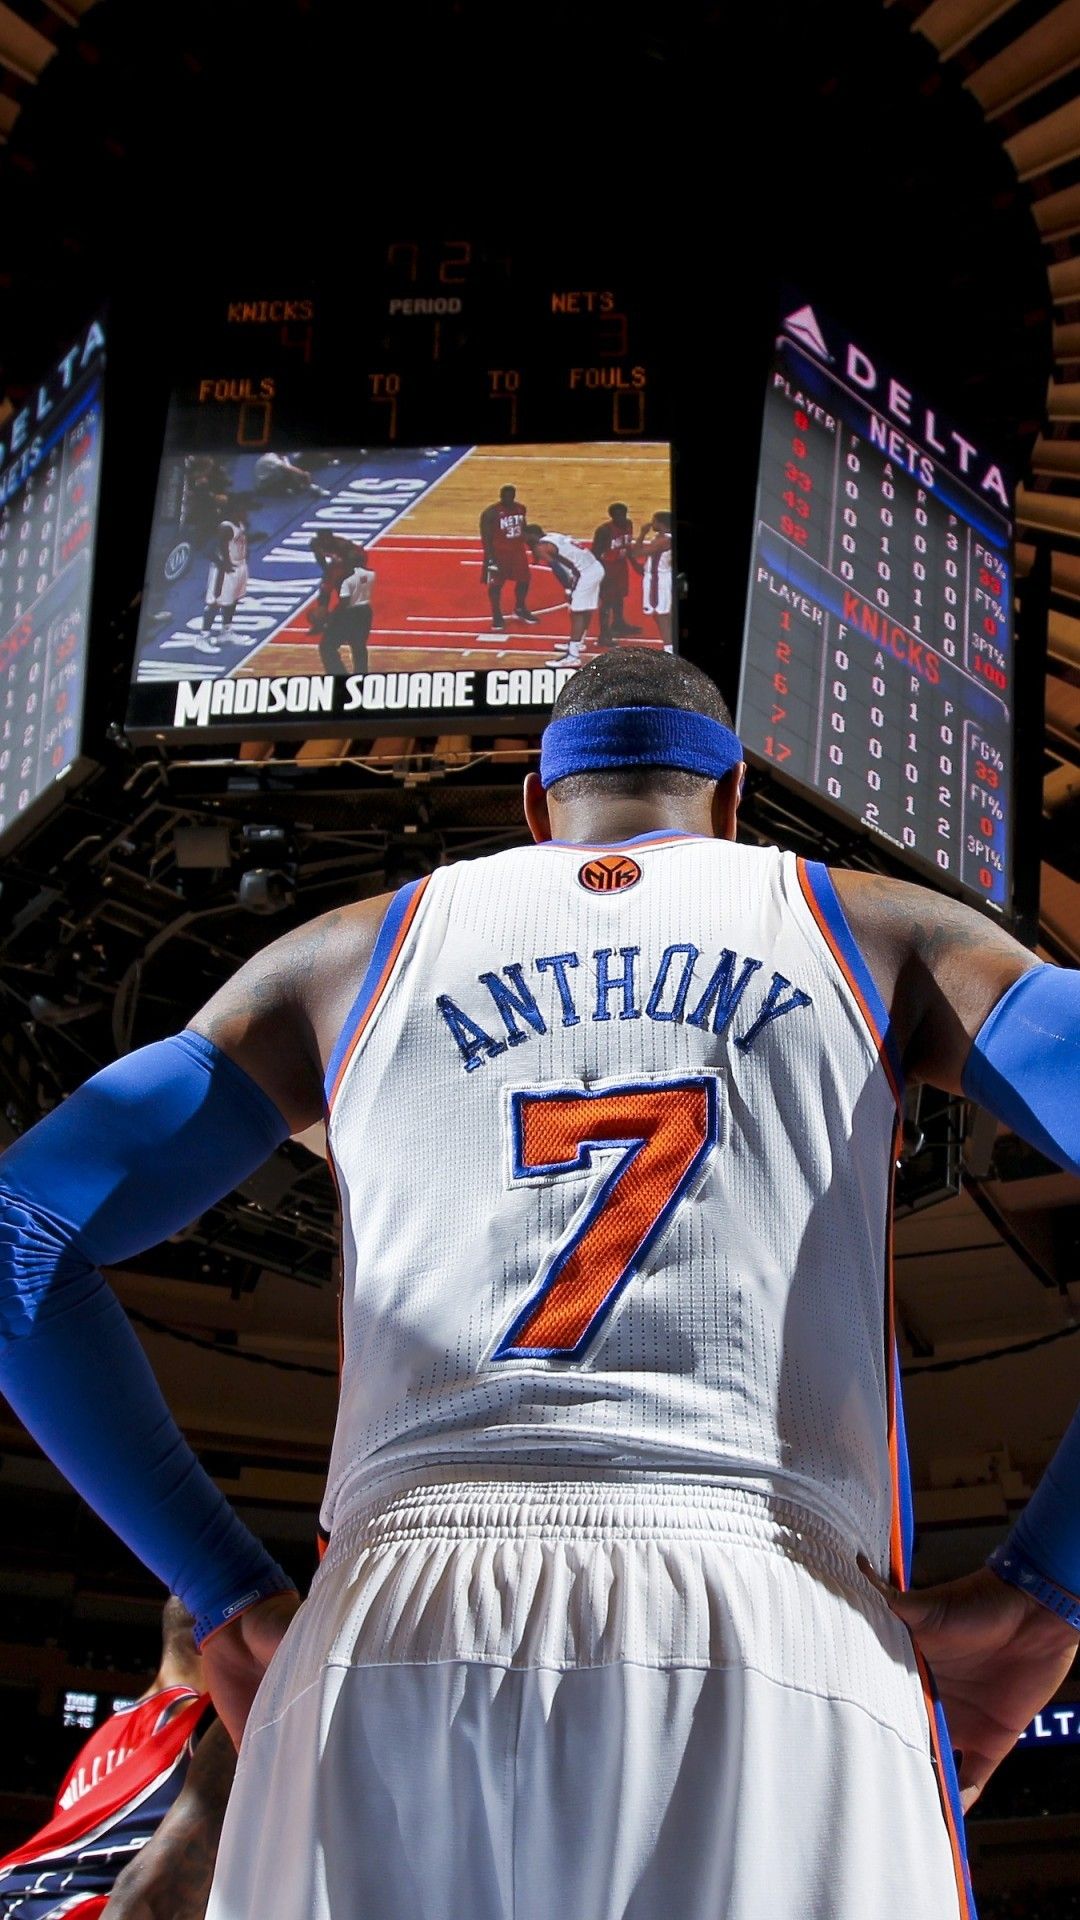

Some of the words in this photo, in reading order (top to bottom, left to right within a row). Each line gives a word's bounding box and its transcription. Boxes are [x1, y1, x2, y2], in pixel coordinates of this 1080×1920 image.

[226, 300, 315, 322] KNICKS
[389, 297, 462, 316] PERIOD
[551, 291, 616, 313] NETS
[281, 322, 314, 363] 4
[598, 311, 629, 357] 3
[0, 322, 105, 467] ELTA
[199, 378, 276, 401] FOULS
[369, 373, 400, 395] TO
[488, 369, 519, 392] TO
[570, 366, 647, 390] FOULS
[237, 400, 272, 446] 0
[612, 391, 645, 434] 0
[774, 373, 836, 432] PLAYER
[846, 343, 1009, 508] DELTA
[869, 414, 934, 488] NETS
[847, 453, 859, 472] 0
[881, 481, 894, 499] 0
[914, 507, 927, 526] 0
[946, 532, 958, 551] 3
[845, 480, 858, 499] 0
[880, 508, 893, 527] 0
[914, 534, 927, 554] 0
[945, 559, 958, 578] 0
[843, 507, 857, 526] 0
[880, 535, 889, 554] 1
[912, 561, 926, 580] 0
[944, 586, 956, 605] 0
[974, 543, 1006, 579] FG%
[842, 533, 856, 553] 0
[877, 561, 891, 580] 0
[913, 588, 922, 606] 1
[943, 612, 956, 631] 0
[840, 560, 854, 580] 0
[876, 587, 889, 607] 0
[912, 614, 921, 632] 1
[943, 638, 956, 657] 0
[974, 587, 1006, 623] FT%
[983, 617, 997, 635] 0
[757, 567, 823, 625] PLAYER
[838, 624, 848, 639] F
[875, 652, 884, 669] A
[911, 677, 920, 693] R
[944, 701, 954, 716] P
[844, 592, 940, 684] KNICKS
[971, 632, 1006, 668] 3PT%
[781, 611, 791, 631] 1
[836, 650, 849, 670] 0
[872, 677, 885, 697] 0
[909, 703, 918, 722] 1
[941, 725, 953, 744] 0
[974, 655, 1007, 690] 100
[173, 676, 334, 728] MADISON
[343, 671, 475, 711] SQUARE
[775, 641, 791, 664] 2
[834, 681, 847, 701] 0
[871, 707, 884, 727] 0
[908, 733, 917, 752] 1
[940, 756, 952, 775] 0
[772, 704, 786, 724] 7
[830, 745, 843, 765] 0
[867, 770, 881, 791] 0
[905, 796, 914, 815] 1
[938, 817, 950, 839] 2
[832, 713, 845, 733] 0
[869, 739, 882, 759] 0
[905, 763, 918, 783] 0
[939, 786, 951, 807] 2
[972, 731, 1003, 772] FG%
[976, 761, 998, 788] 33
[764, 736, 791, 761] 17
[828, 777, 841, 798] 0
[866, 803, 879, 825] 2
[903, 826, 916, 847] 0
[937, 848, 949, 869] 0
[971, 785, 1003, 820] FT%
[981, 817, 993, 836] 0
[968, 836, 1003, 872] 3PT%
[981, 868, 993, 888] 0
[435, 943, 813, 1074] ANTHONY
[494, 1077, 717, 1361] 7
[1018, 1711, 1080, 1739] LT
